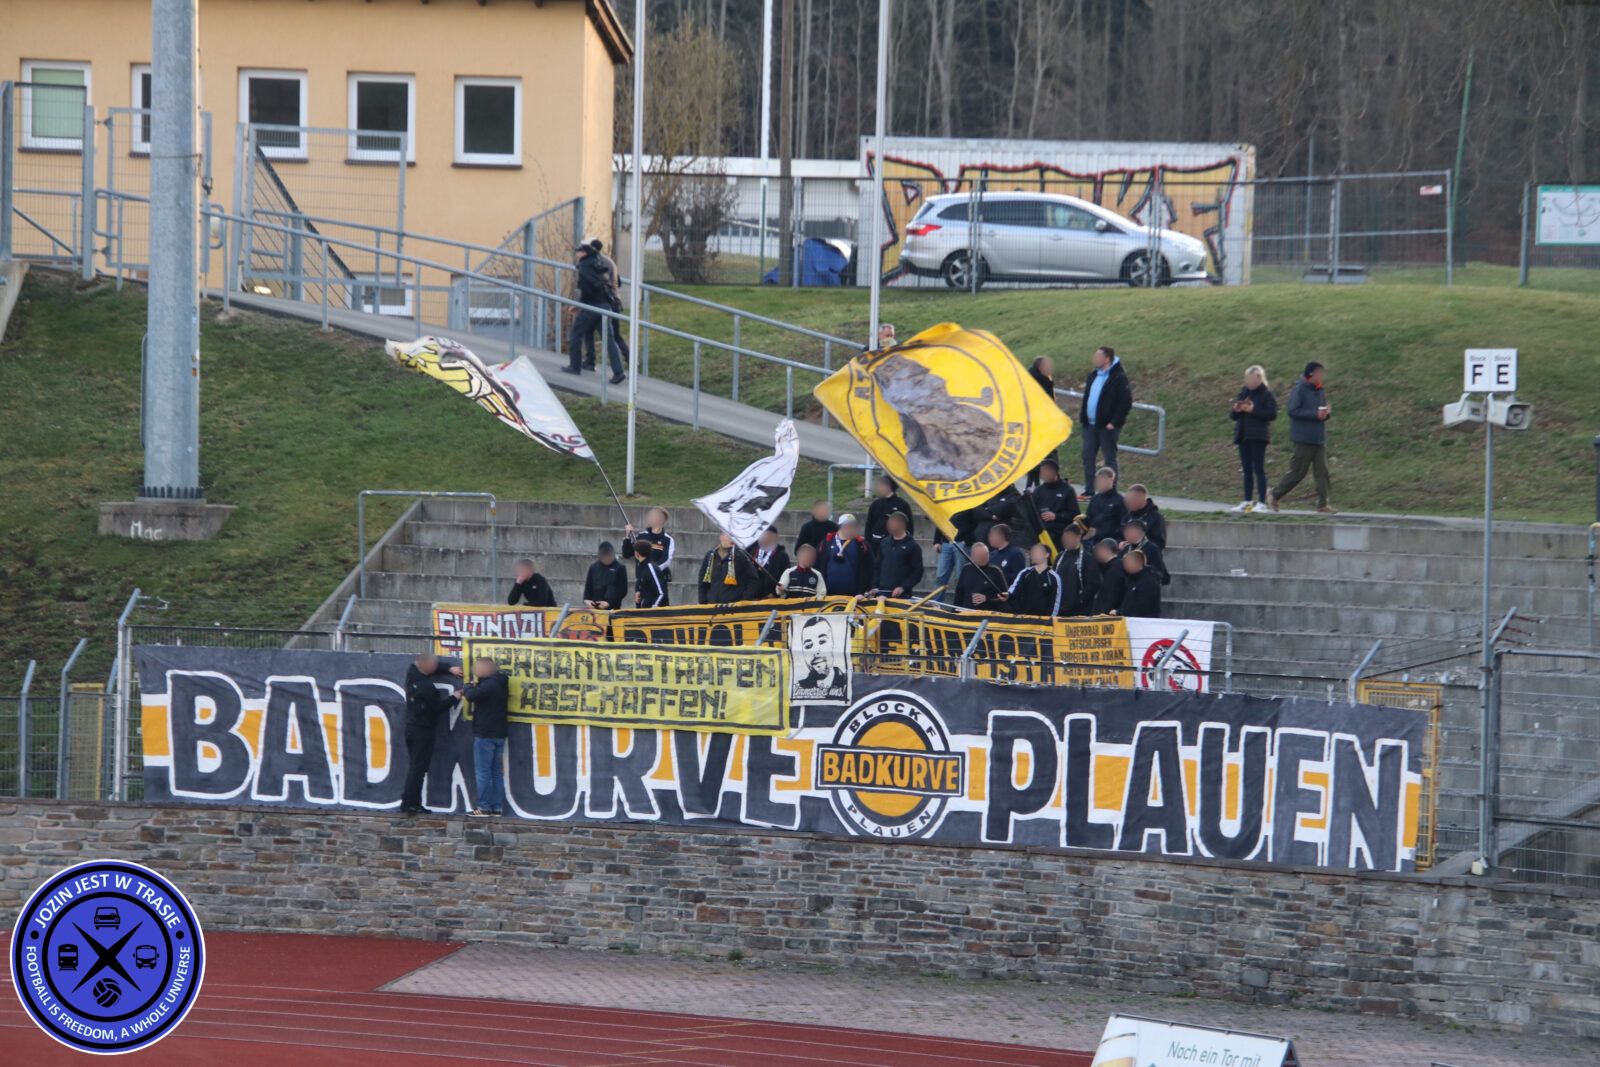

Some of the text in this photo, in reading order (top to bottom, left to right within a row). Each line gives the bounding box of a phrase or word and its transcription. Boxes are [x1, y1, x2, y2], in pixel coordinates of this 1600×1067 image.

[1471, 364, 1484, 385] F
[1496, 364, 1509, 385] E
[520, 681, 728, 720] ABSCHAFFEN!
[849, 702, 937, 738] BLOCK F
[823, 752, 958, 790] BADKURVE
[980, 710, 1408, 872] PLAUEN
[846, 804, 932, 837] PLAUEN
[1167, 1041, 1262, 1067] Noch ein Tor mit
